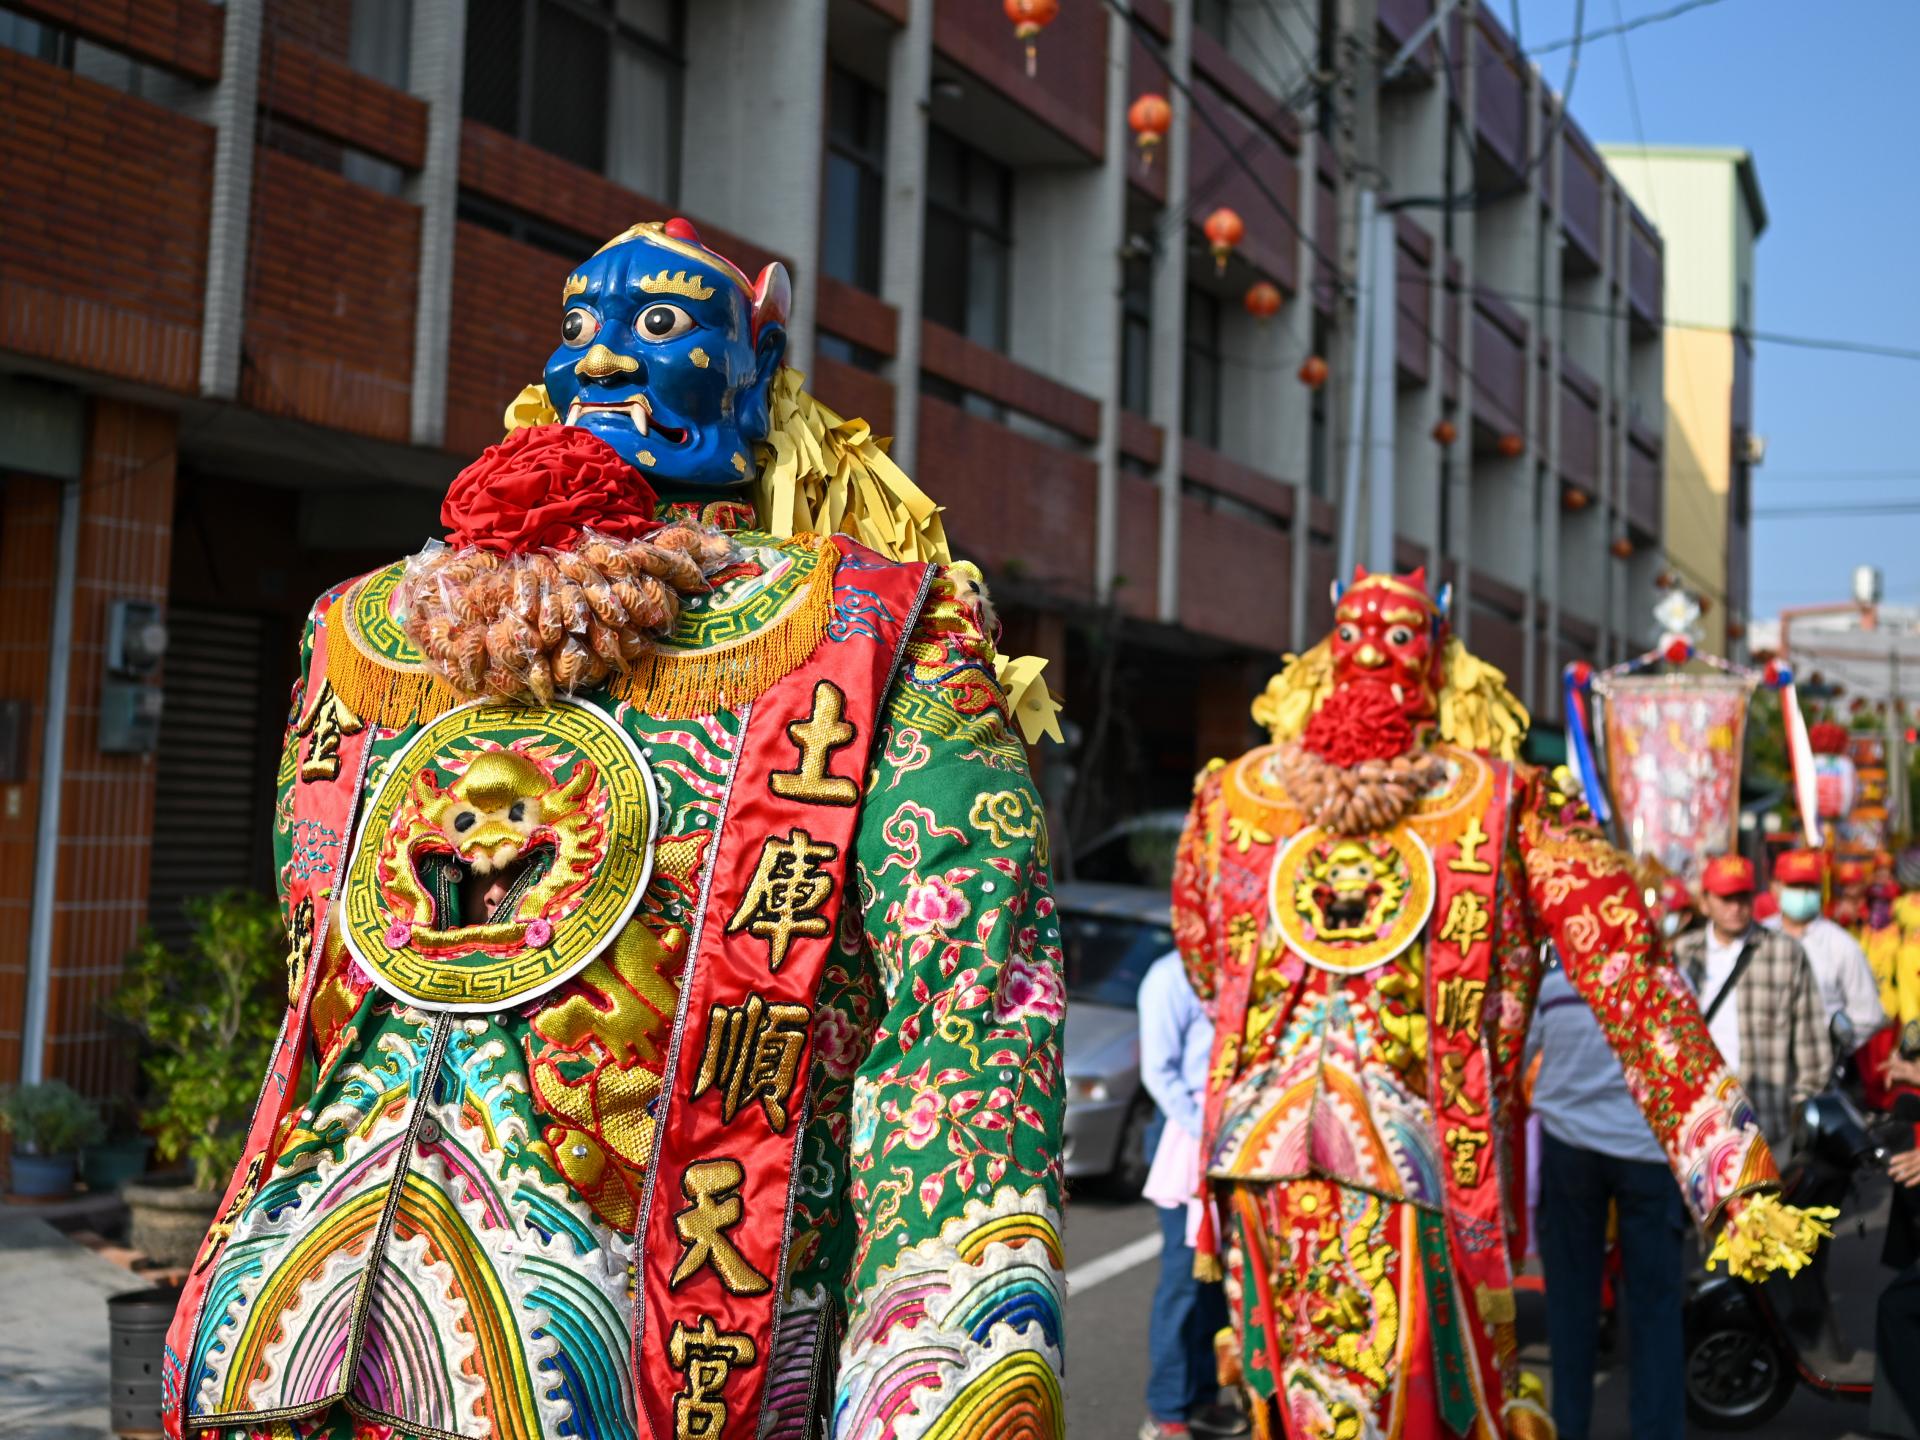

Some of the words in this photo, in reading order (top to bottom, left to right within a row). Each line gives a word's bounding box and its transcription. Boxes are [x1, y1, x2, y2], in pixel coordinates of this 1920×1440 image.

[667, 678, 859, 1440] 土庫順天宮
[1436, 815, 1493, 1189] 土庫順天宮
